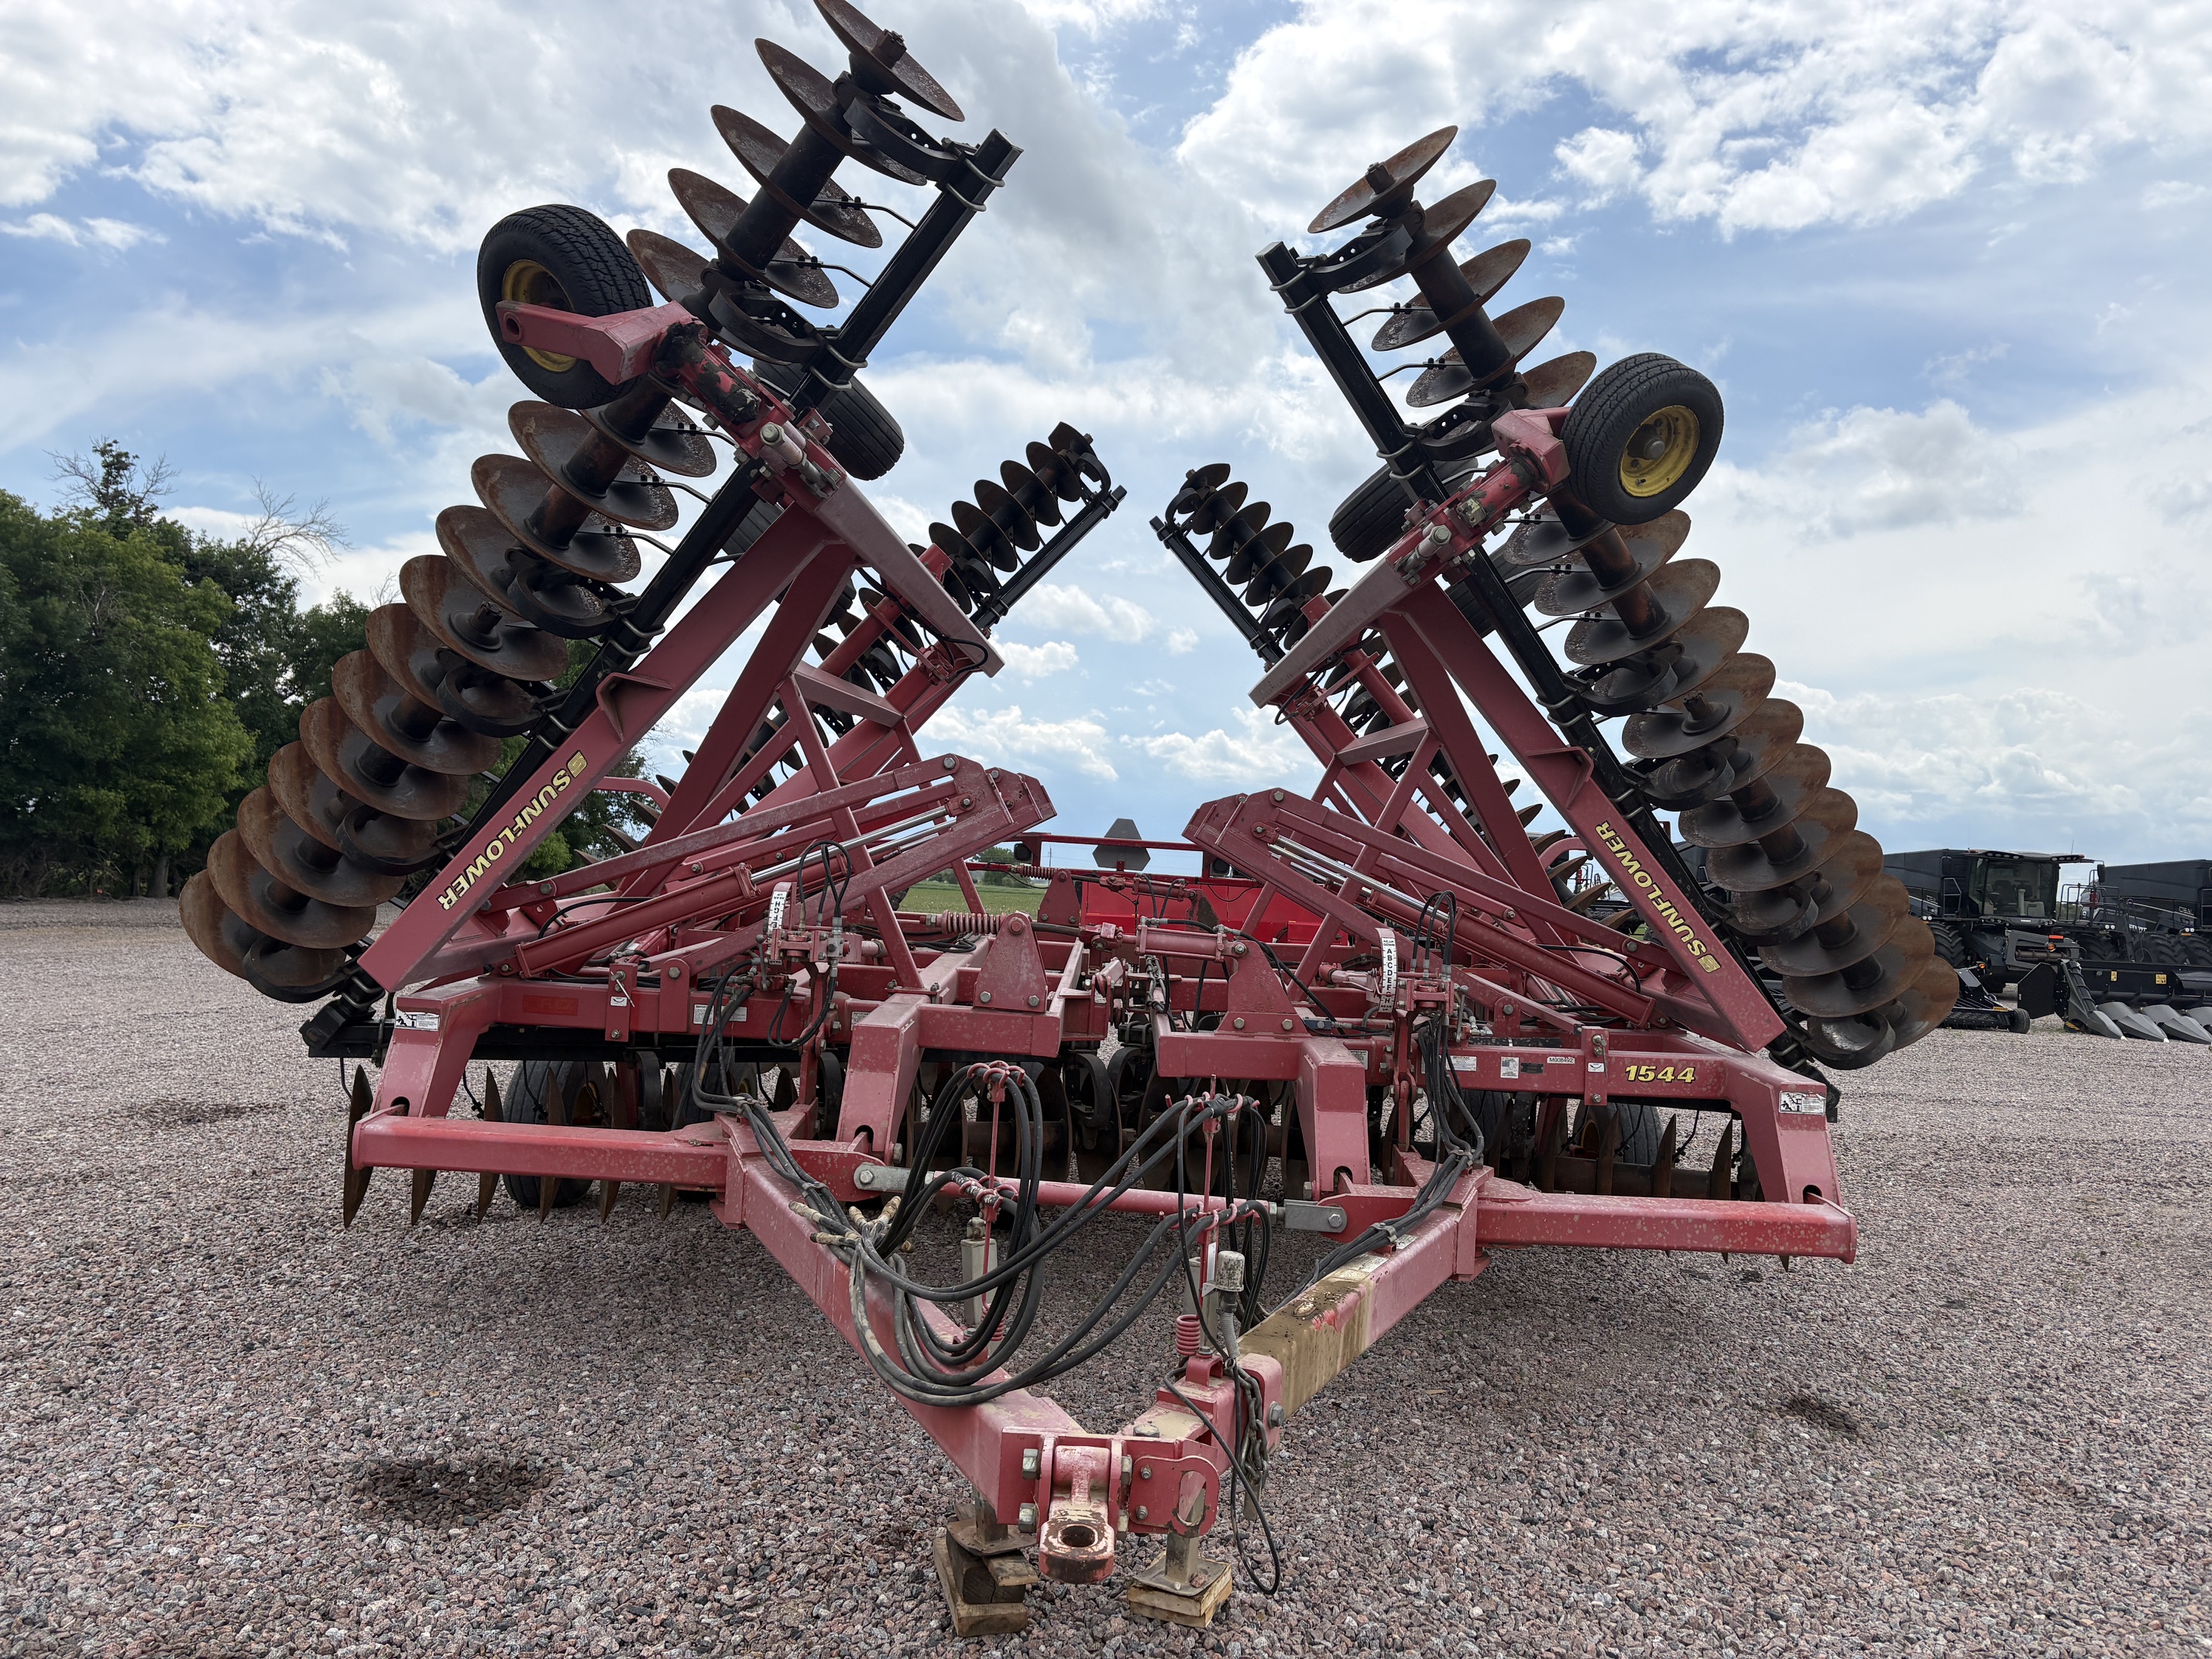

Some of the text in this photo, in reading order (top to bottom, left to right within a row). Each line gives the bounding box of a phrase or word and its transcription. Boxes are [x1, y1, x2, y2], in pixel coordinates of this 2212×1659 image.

[436, 768, 572, 911] SUNFLOWER
[1595, 819, 1708, 957] SUNFLOWER
[1625, 1065, 1695, 1084] 1544
